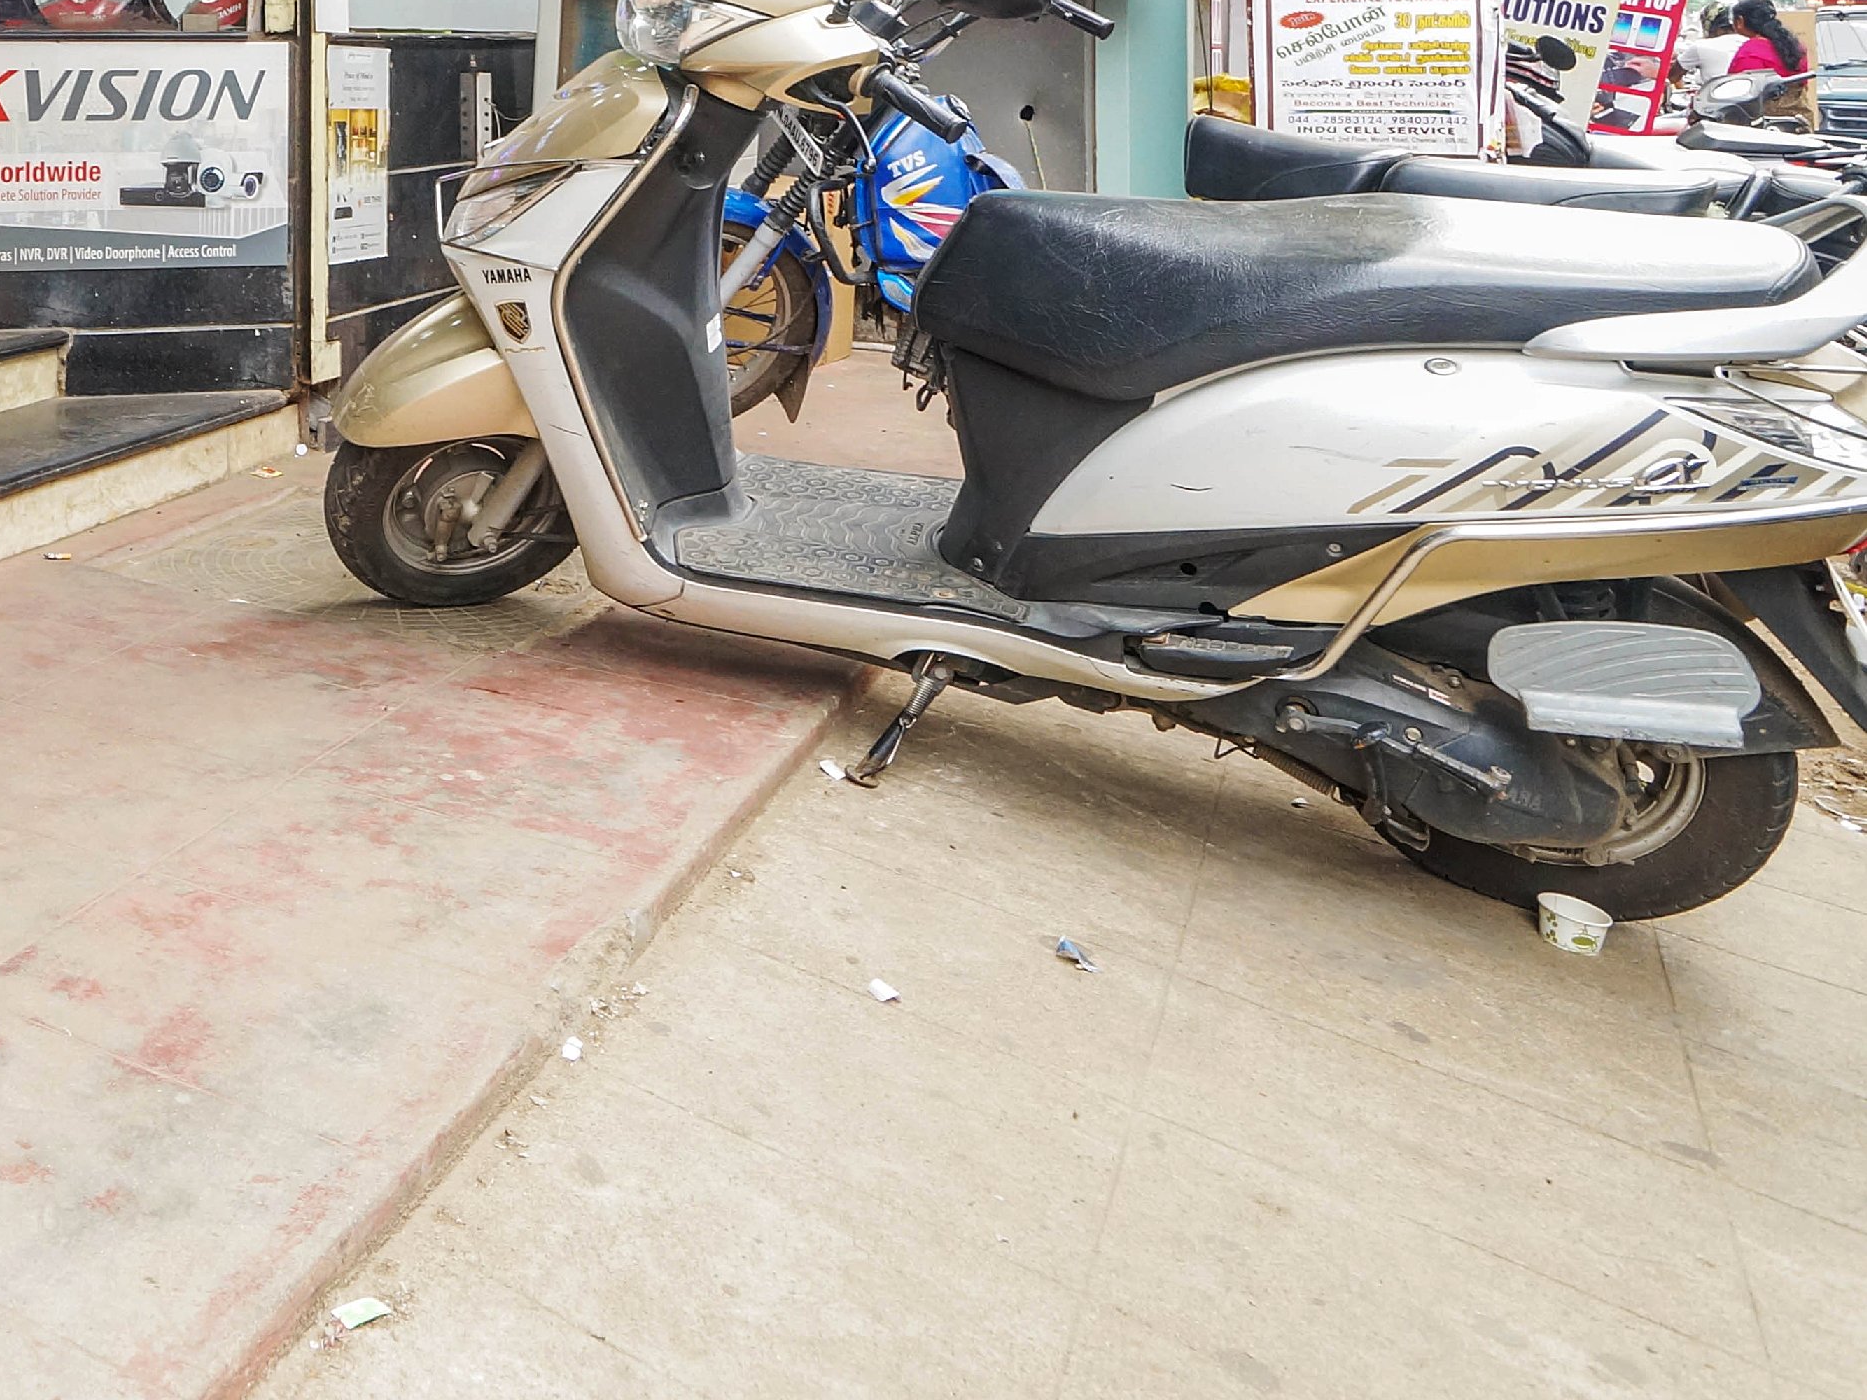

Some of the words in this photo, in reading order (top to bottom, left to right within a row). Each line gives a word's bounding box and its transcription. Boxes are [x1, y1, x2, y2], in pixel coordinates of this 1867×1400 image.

[1394, 11, 1412, 29] 30
[1294, 99, 1345, 108] Become
[1356, 99, 1383, 107] Best
[1388, 99, 1455, 108] Technician
[1288, 116, 1310, 124] 044
[1296, 126, 1337, 134] INDU
[1344, 126, 1381, 134] CELL
[1387, 126, 1457, 136] SERVICE
[886, 149, 927, 179] TVS
[18, 187, 60, 202] Solution
[61, 187, 102, 201] Provider
[19, 247, 45, 262] NVR,
[46, 247, 68, 261] DVR
[75, 246, 103, 261] Video
[105, 245, 161, 263] Doorphone
[167, 245, 199, 259] Access
[200, 244, 237, 258] Control
[481, 267, 533, 285] YAMAHA
